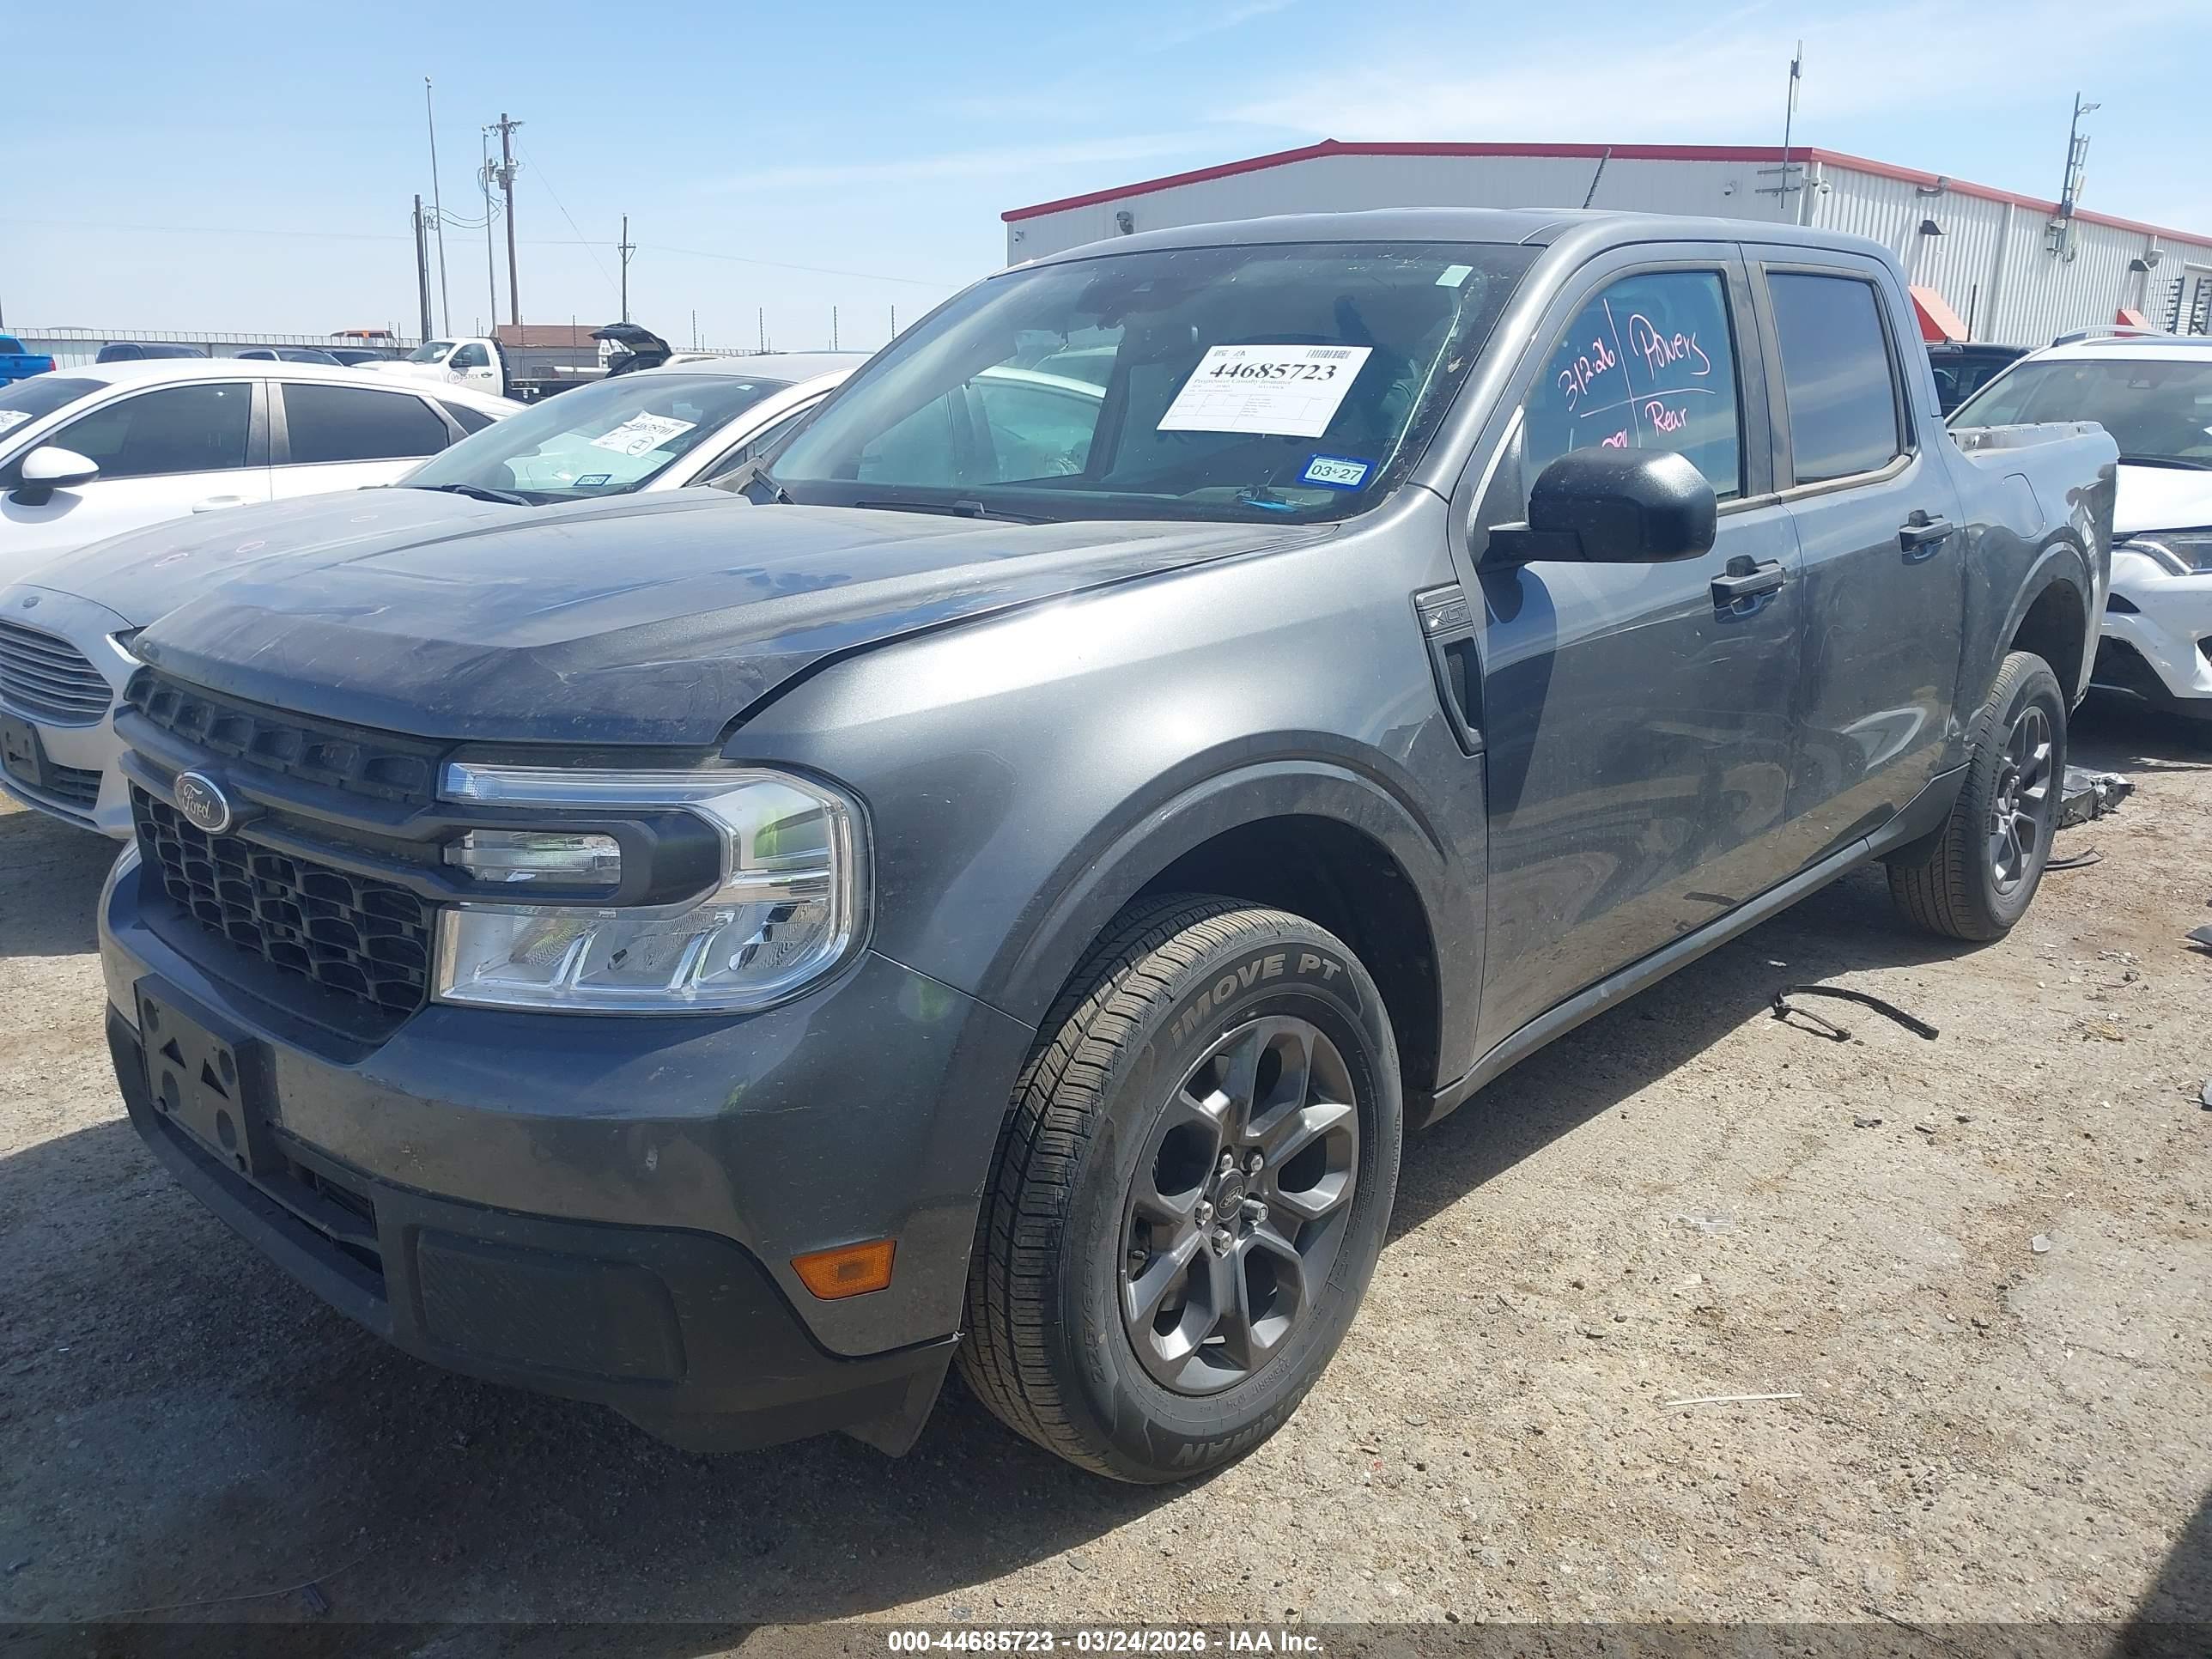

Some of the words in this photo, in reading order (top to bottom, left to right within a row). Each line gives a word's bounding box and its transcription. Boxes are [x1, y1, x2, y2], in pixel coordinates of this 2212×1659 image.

[1210, 362, 1337, 380] 44685723
[1644, 400, 1686, 437] Rear
[1428, 606, 1468, 628] XLT
[183, 783, 211, 820] Ford
[1170, 953, 1286, 1052] iMOVE
[1297, 953, 1341, 981] PT
